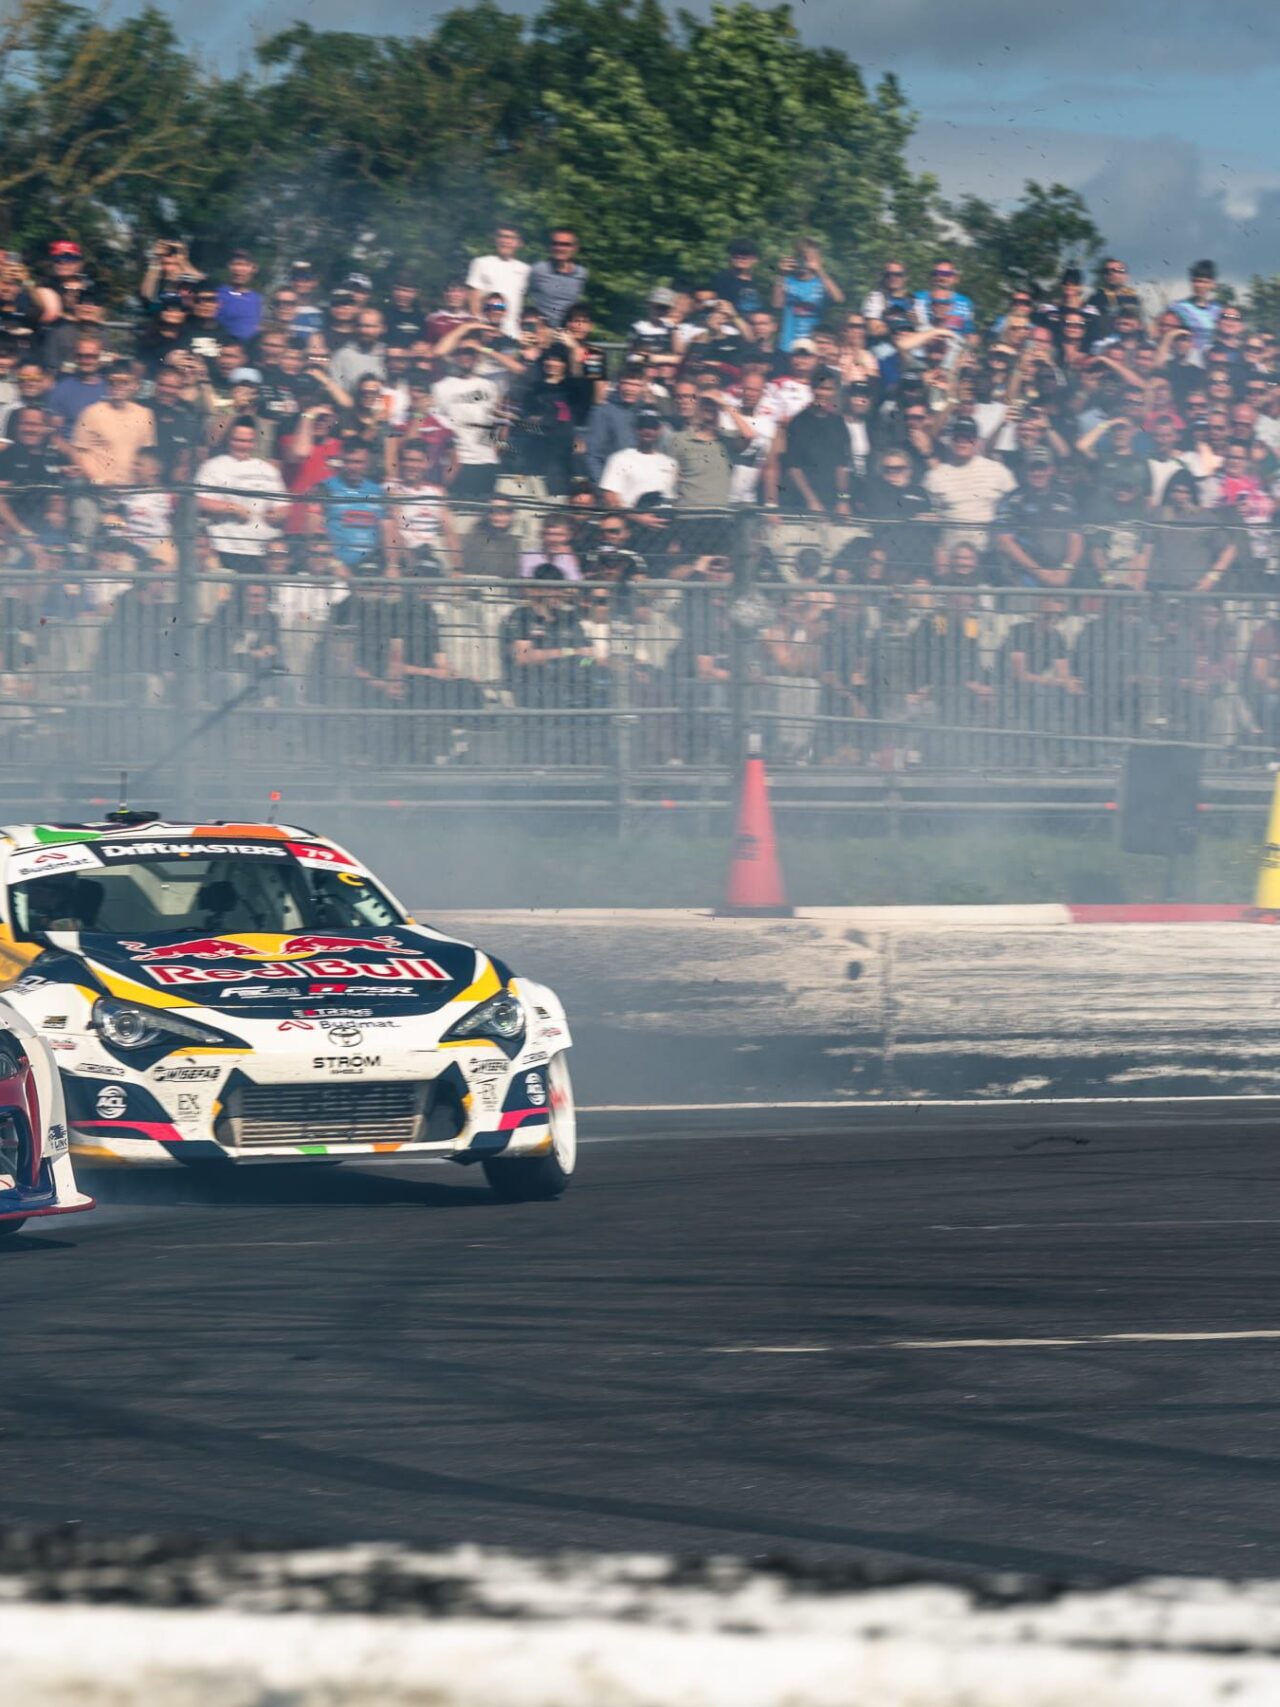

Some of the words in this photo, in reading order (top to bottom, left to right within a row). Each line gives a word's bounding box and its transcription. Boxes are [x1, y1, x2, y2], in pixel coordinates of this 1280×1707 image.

[300, 847, 335, 860] 79
[336, 872, 366, 887] C
[142, 962, 307, 985] Red
[299, 958, 454, 981] Bull
